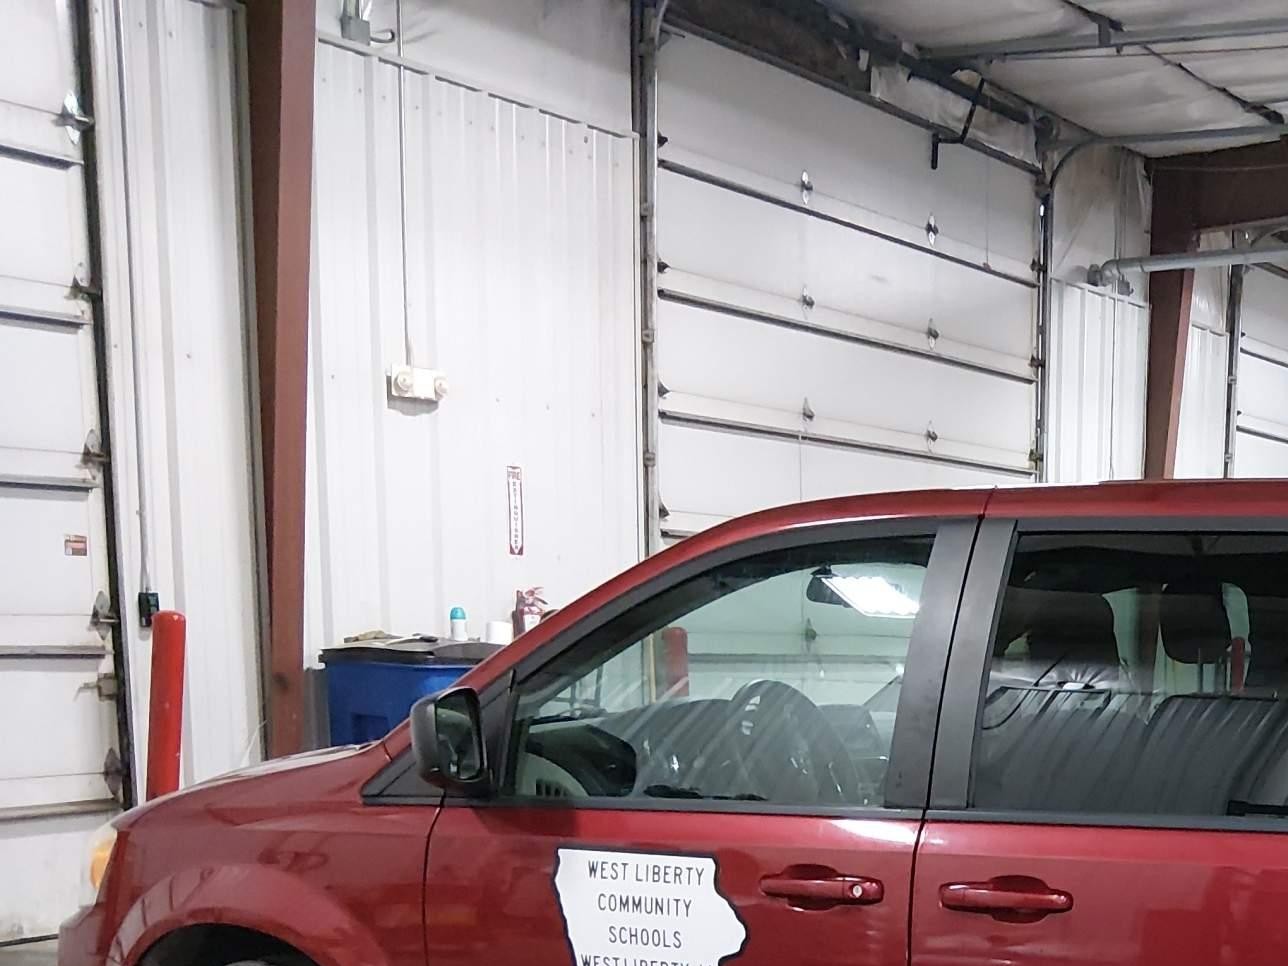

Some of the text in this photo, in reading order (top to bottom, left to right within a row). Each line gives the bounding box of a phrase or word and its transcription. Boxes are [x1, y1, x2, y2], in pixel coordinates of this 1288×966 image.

[588, 860, 705, 885] WEST LIBERTY
[598, 893, 692, 917] COMMUNITY
[608, 926, 682, 949] SCHOOLS
